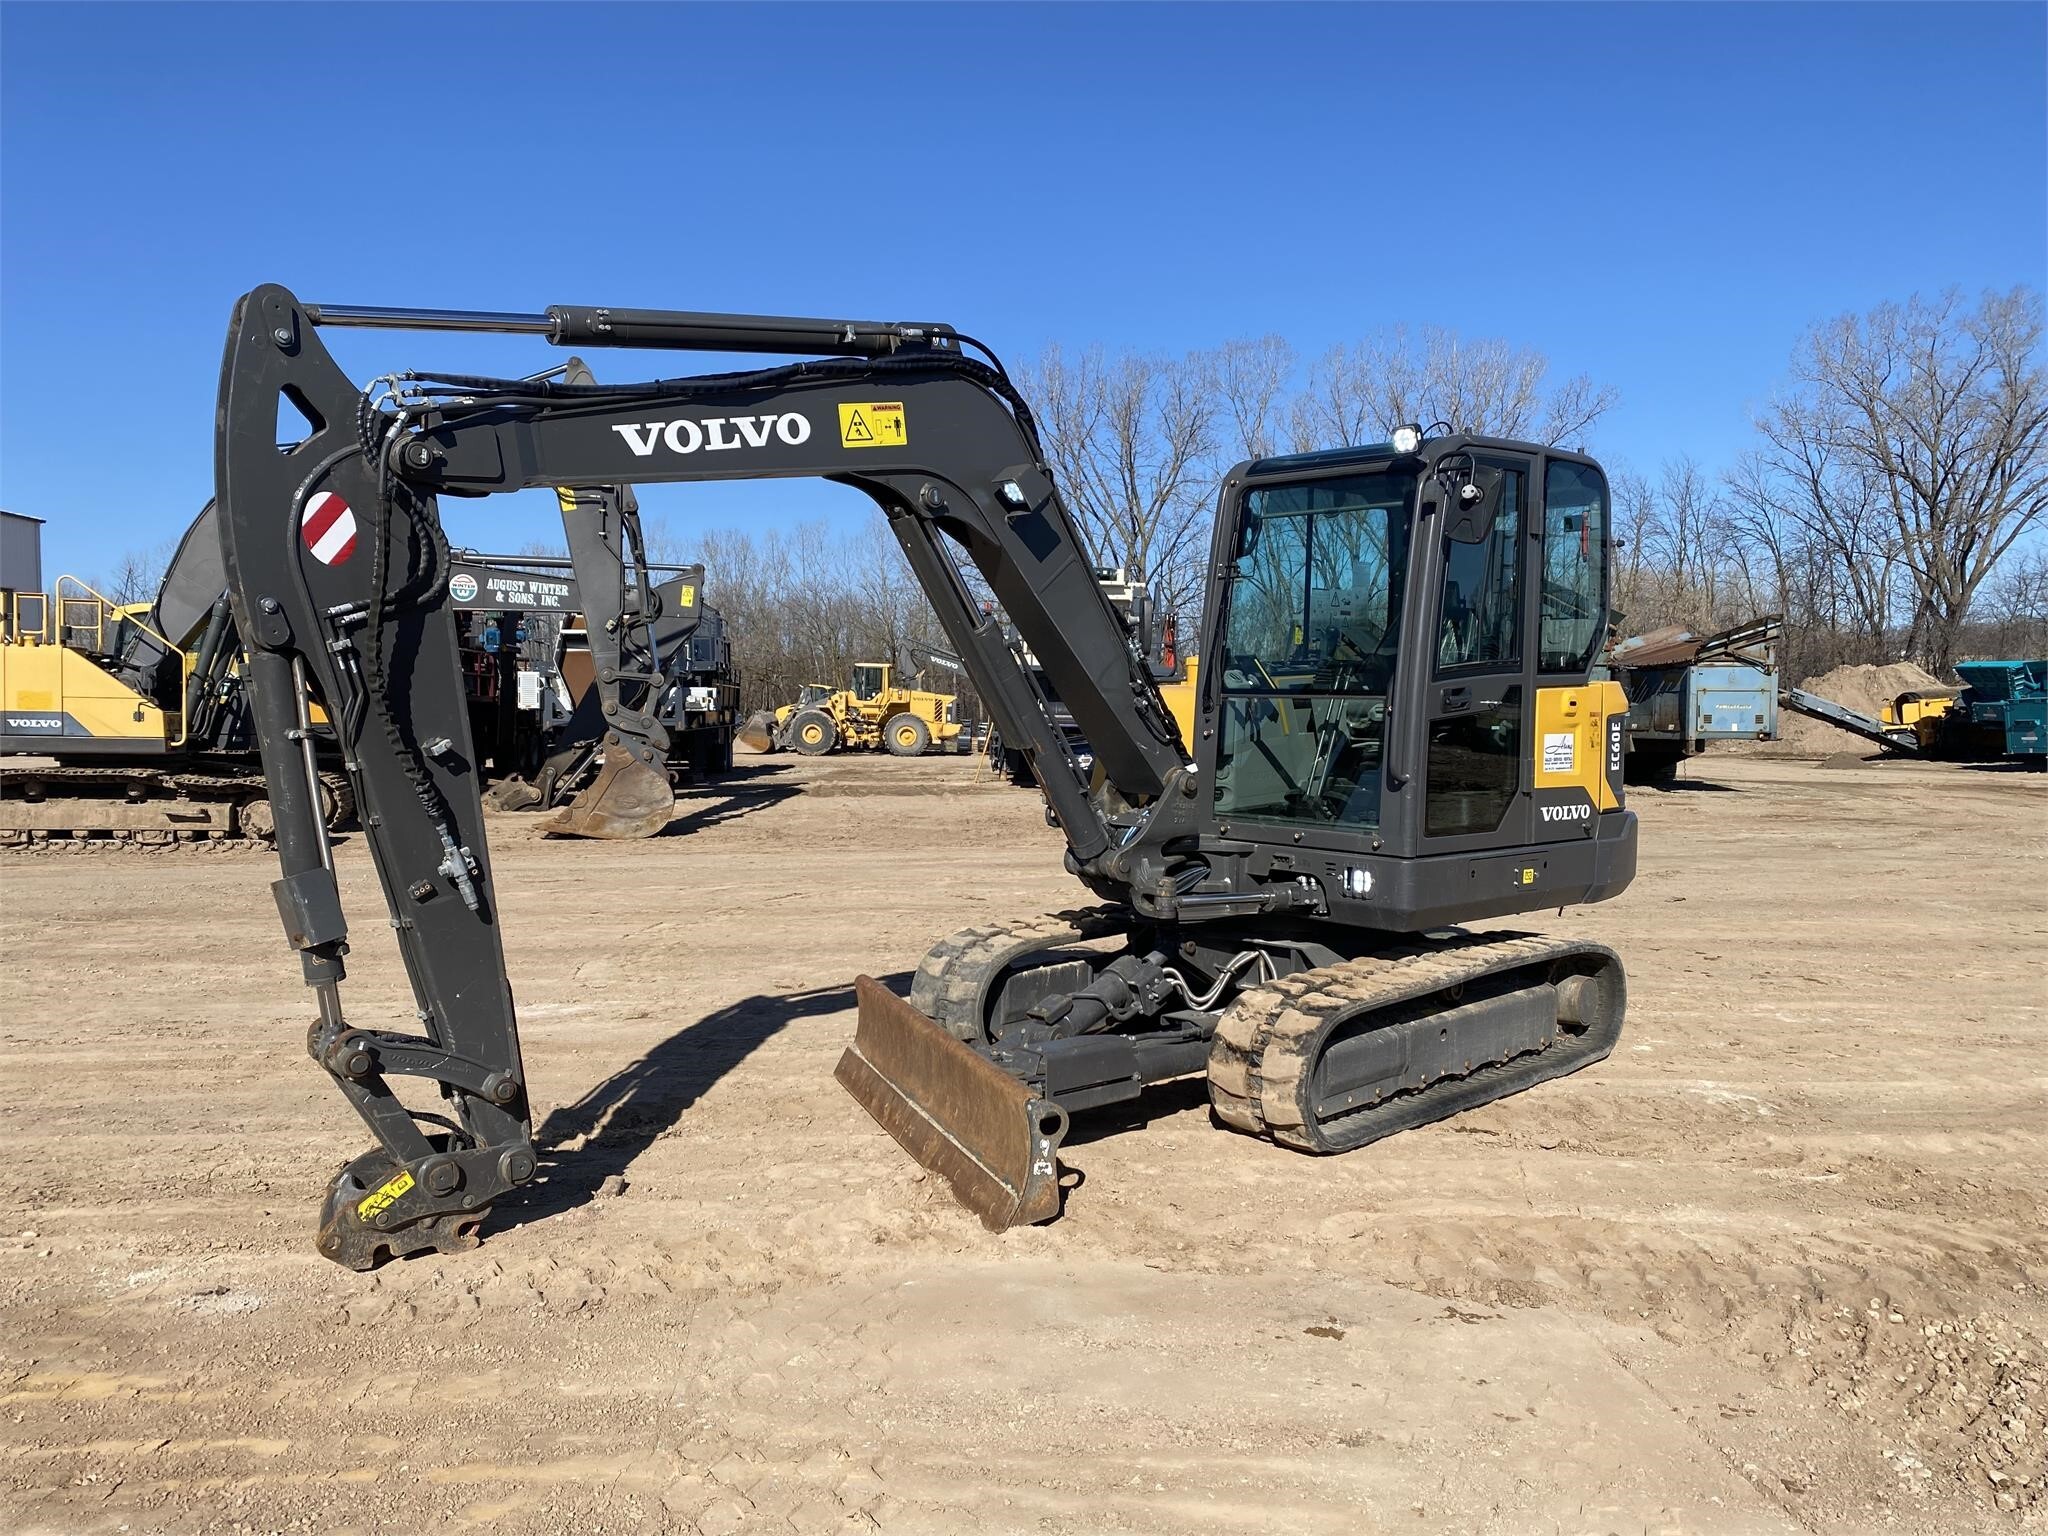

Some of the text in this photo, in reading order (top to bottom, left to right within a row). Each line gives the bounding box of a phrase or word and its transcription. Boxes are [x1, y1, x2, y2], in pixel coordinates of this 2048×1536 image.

[612, 412, 811, 456] VOLVO
[487, 578, 569, 596] AUGUST WINTER
[495, 591, 561, 607] & SONS, INC.
[930, 656, 958, 669] VOLVO
[6, 719, 62, 728] VOLVO
[1611, 722, 1620, 770] EC60E
[1540, 804, 1590, 822] VOLVO
